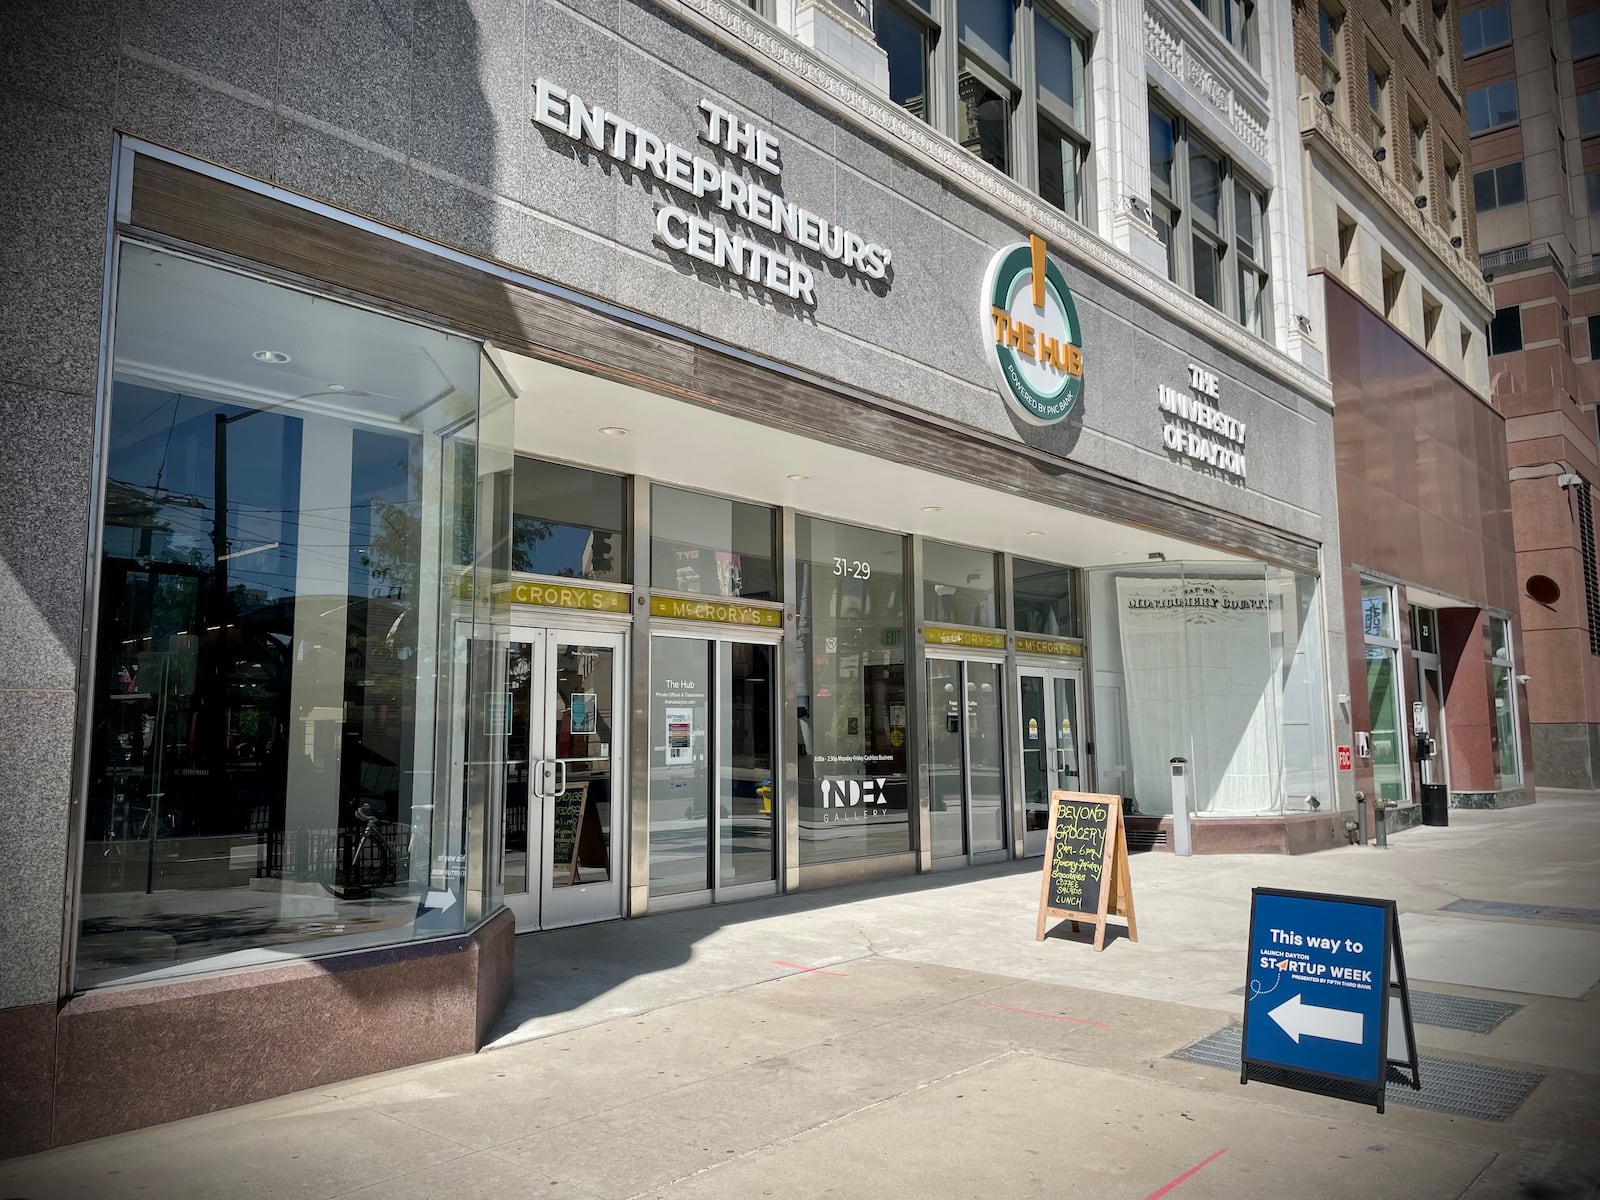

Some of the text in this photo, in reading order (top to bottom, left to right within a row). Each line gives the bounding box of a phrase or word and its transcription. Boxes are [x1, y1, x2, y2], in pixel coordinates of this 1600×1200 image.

[700, 99, 781, 176] THE
[535, 78, 892, 280] ENTREPRENEURS'
[656, 206, 814, 306] CENTER
[991, 307, 1083, 377] THE HUB
[1008, 364, 1075, 415] POWERED BY PNC BANK
[1189, 363, 1220, 399] THE
[1159, 383, 1247, 445] UNIVERSITY
[1163, 424, 1247, 478] OF DAYTON
[833, 556, 871, 580] 31-29
[515, 584, 603, 610] CRORY'S
[1128, 597, 1274, 611] MONTGOMERY COUNTY
[666, 680, 695, 689] The Hub
[1339, 751, 1350, 766] FDC
[821, 777, 888, 809] INDEX
[823, 808, 887, 823] GALLERY
[1057, 804, 1107, 828] BEYOND
[1055, 824, 1106, 852] GROCERY
[1056, 896, 1082, 909] LUNCH
[1270, 928, 1364, 954] This way to
[1260, 949, 1310, 961] LAUNCH DAYTON
[1260, 956, 1373, 983] STARTUP WEEK
[1291, 974, 1320, 983] PRESENTED
[1326, 979, 1342, 987] FIFTH
[1341, 981, 1357, 989] THIRD
